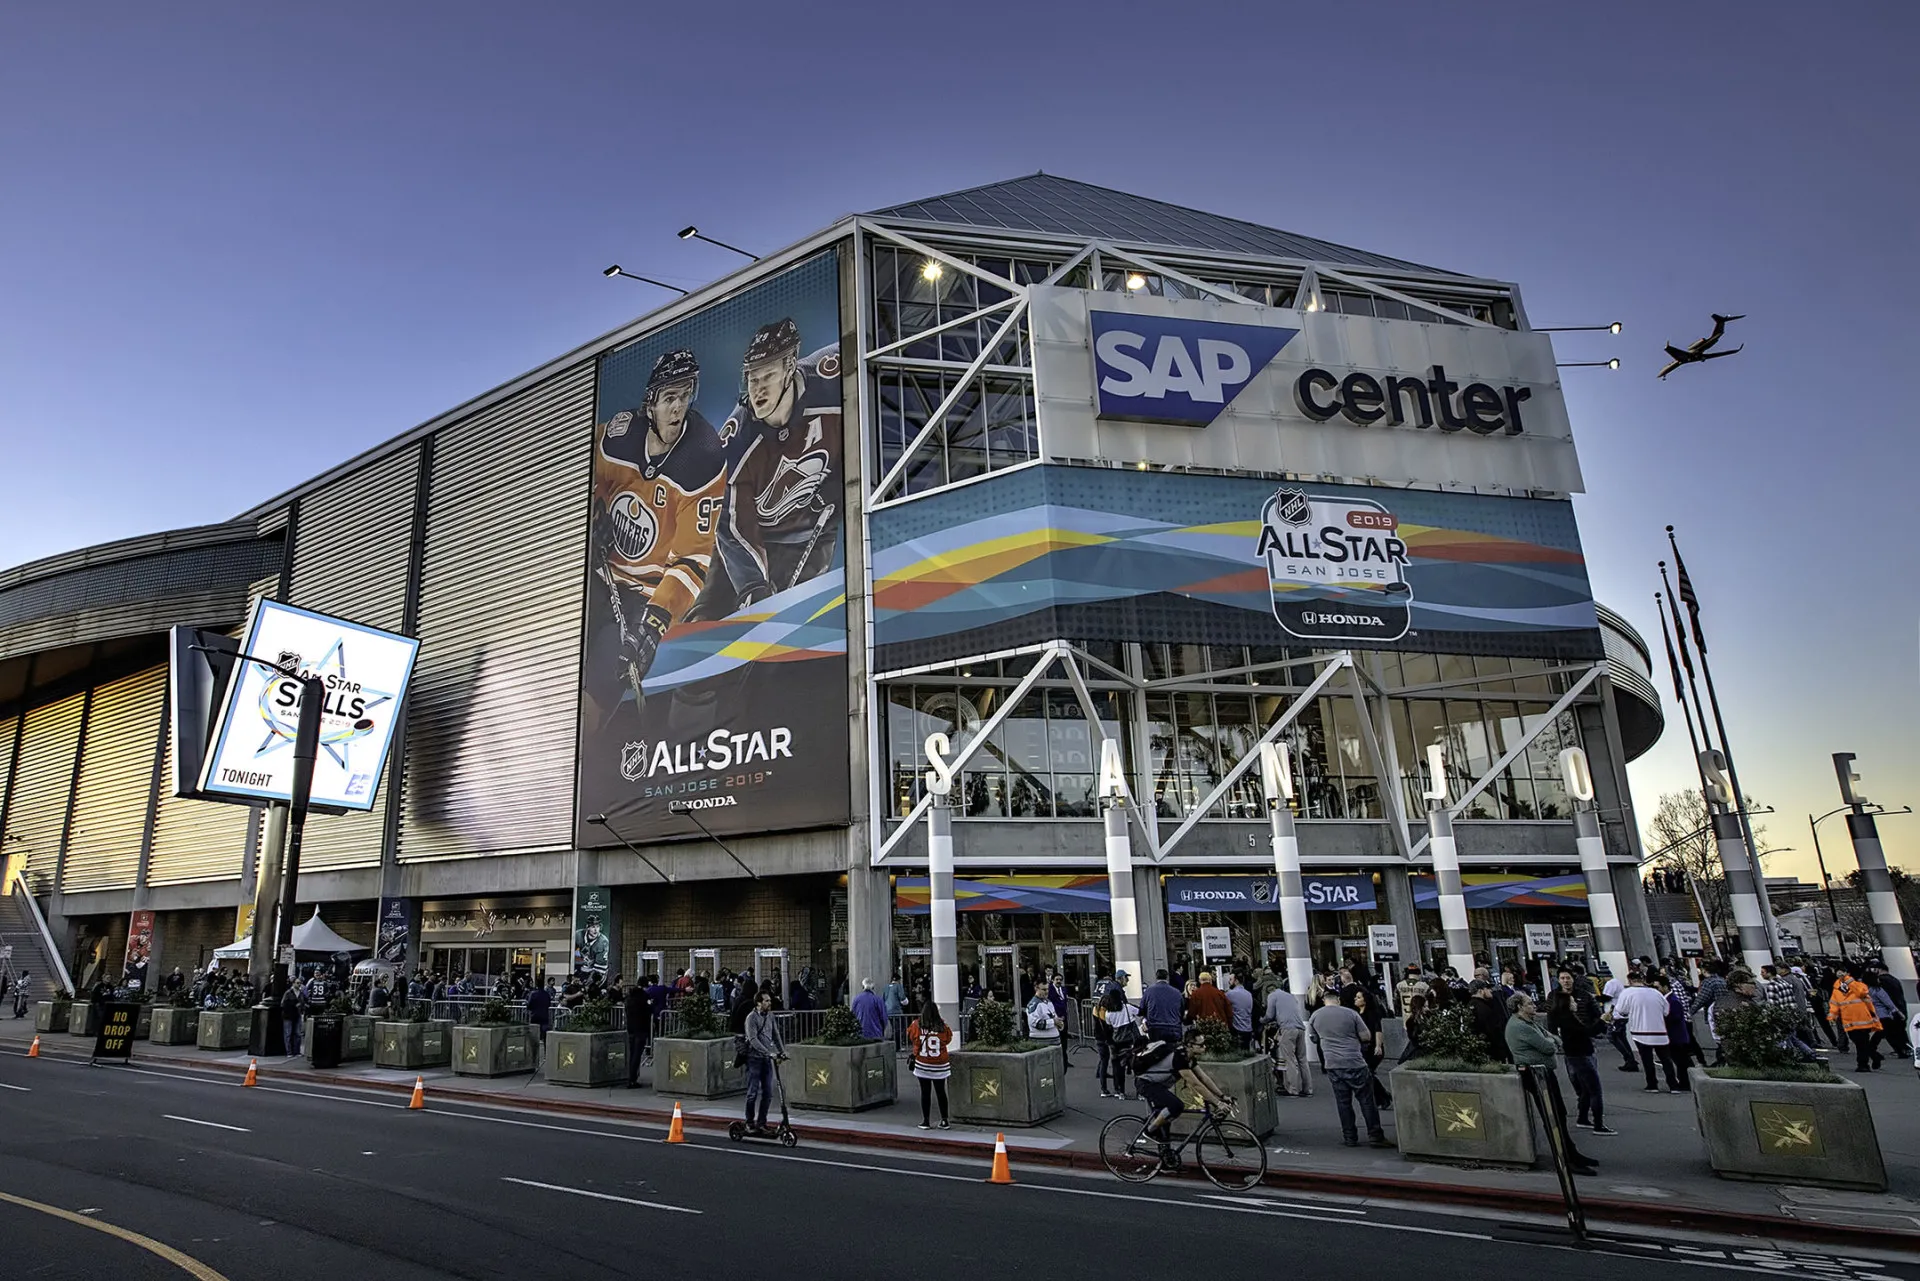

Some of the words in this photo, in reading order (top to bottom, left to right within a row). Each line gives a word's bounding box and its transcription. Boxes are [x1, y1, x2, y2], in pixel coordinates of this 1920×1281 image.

[1096, 330, 1252, 403] SAP
[1293, 364, 1532, 436] center
[803, 416, 823, 452] A
[653, 484, 666, 508] C
[1284, 499, 1304, 518] NHL
[1353, 515, 1392, 527] 2019
[615, 509, 650, 554] OILERS
[1287, 565, 1326, 576] SAN
[1337, 567, 1386, 579] JOSE
[1318, 613, 1385, 626] HONDA
[325, 674, 361, 694] STAR
[275, 681, 366, 719] SLLS
[626, 752, 643, 773] NHL
[222, 768, 273, 787] TONIGHT
[644, 785, 674, 798] SAN
[678, 778, 719, 793] JOSE
[725, 772, 764, 787] 2019
[1193, 890, 1247, 901] HONDA
[1540, 939, 1550, 947] Bags
[312, 985, 324, 996] 39
[1094, 984, 1106, 993] 14
[113, 1011, 128, 1023] NO
[104, 1025, 131, 1036] DROP
[105, 1039, 124, 1050] OFF
[919, 1035, 940, 1057] 19
